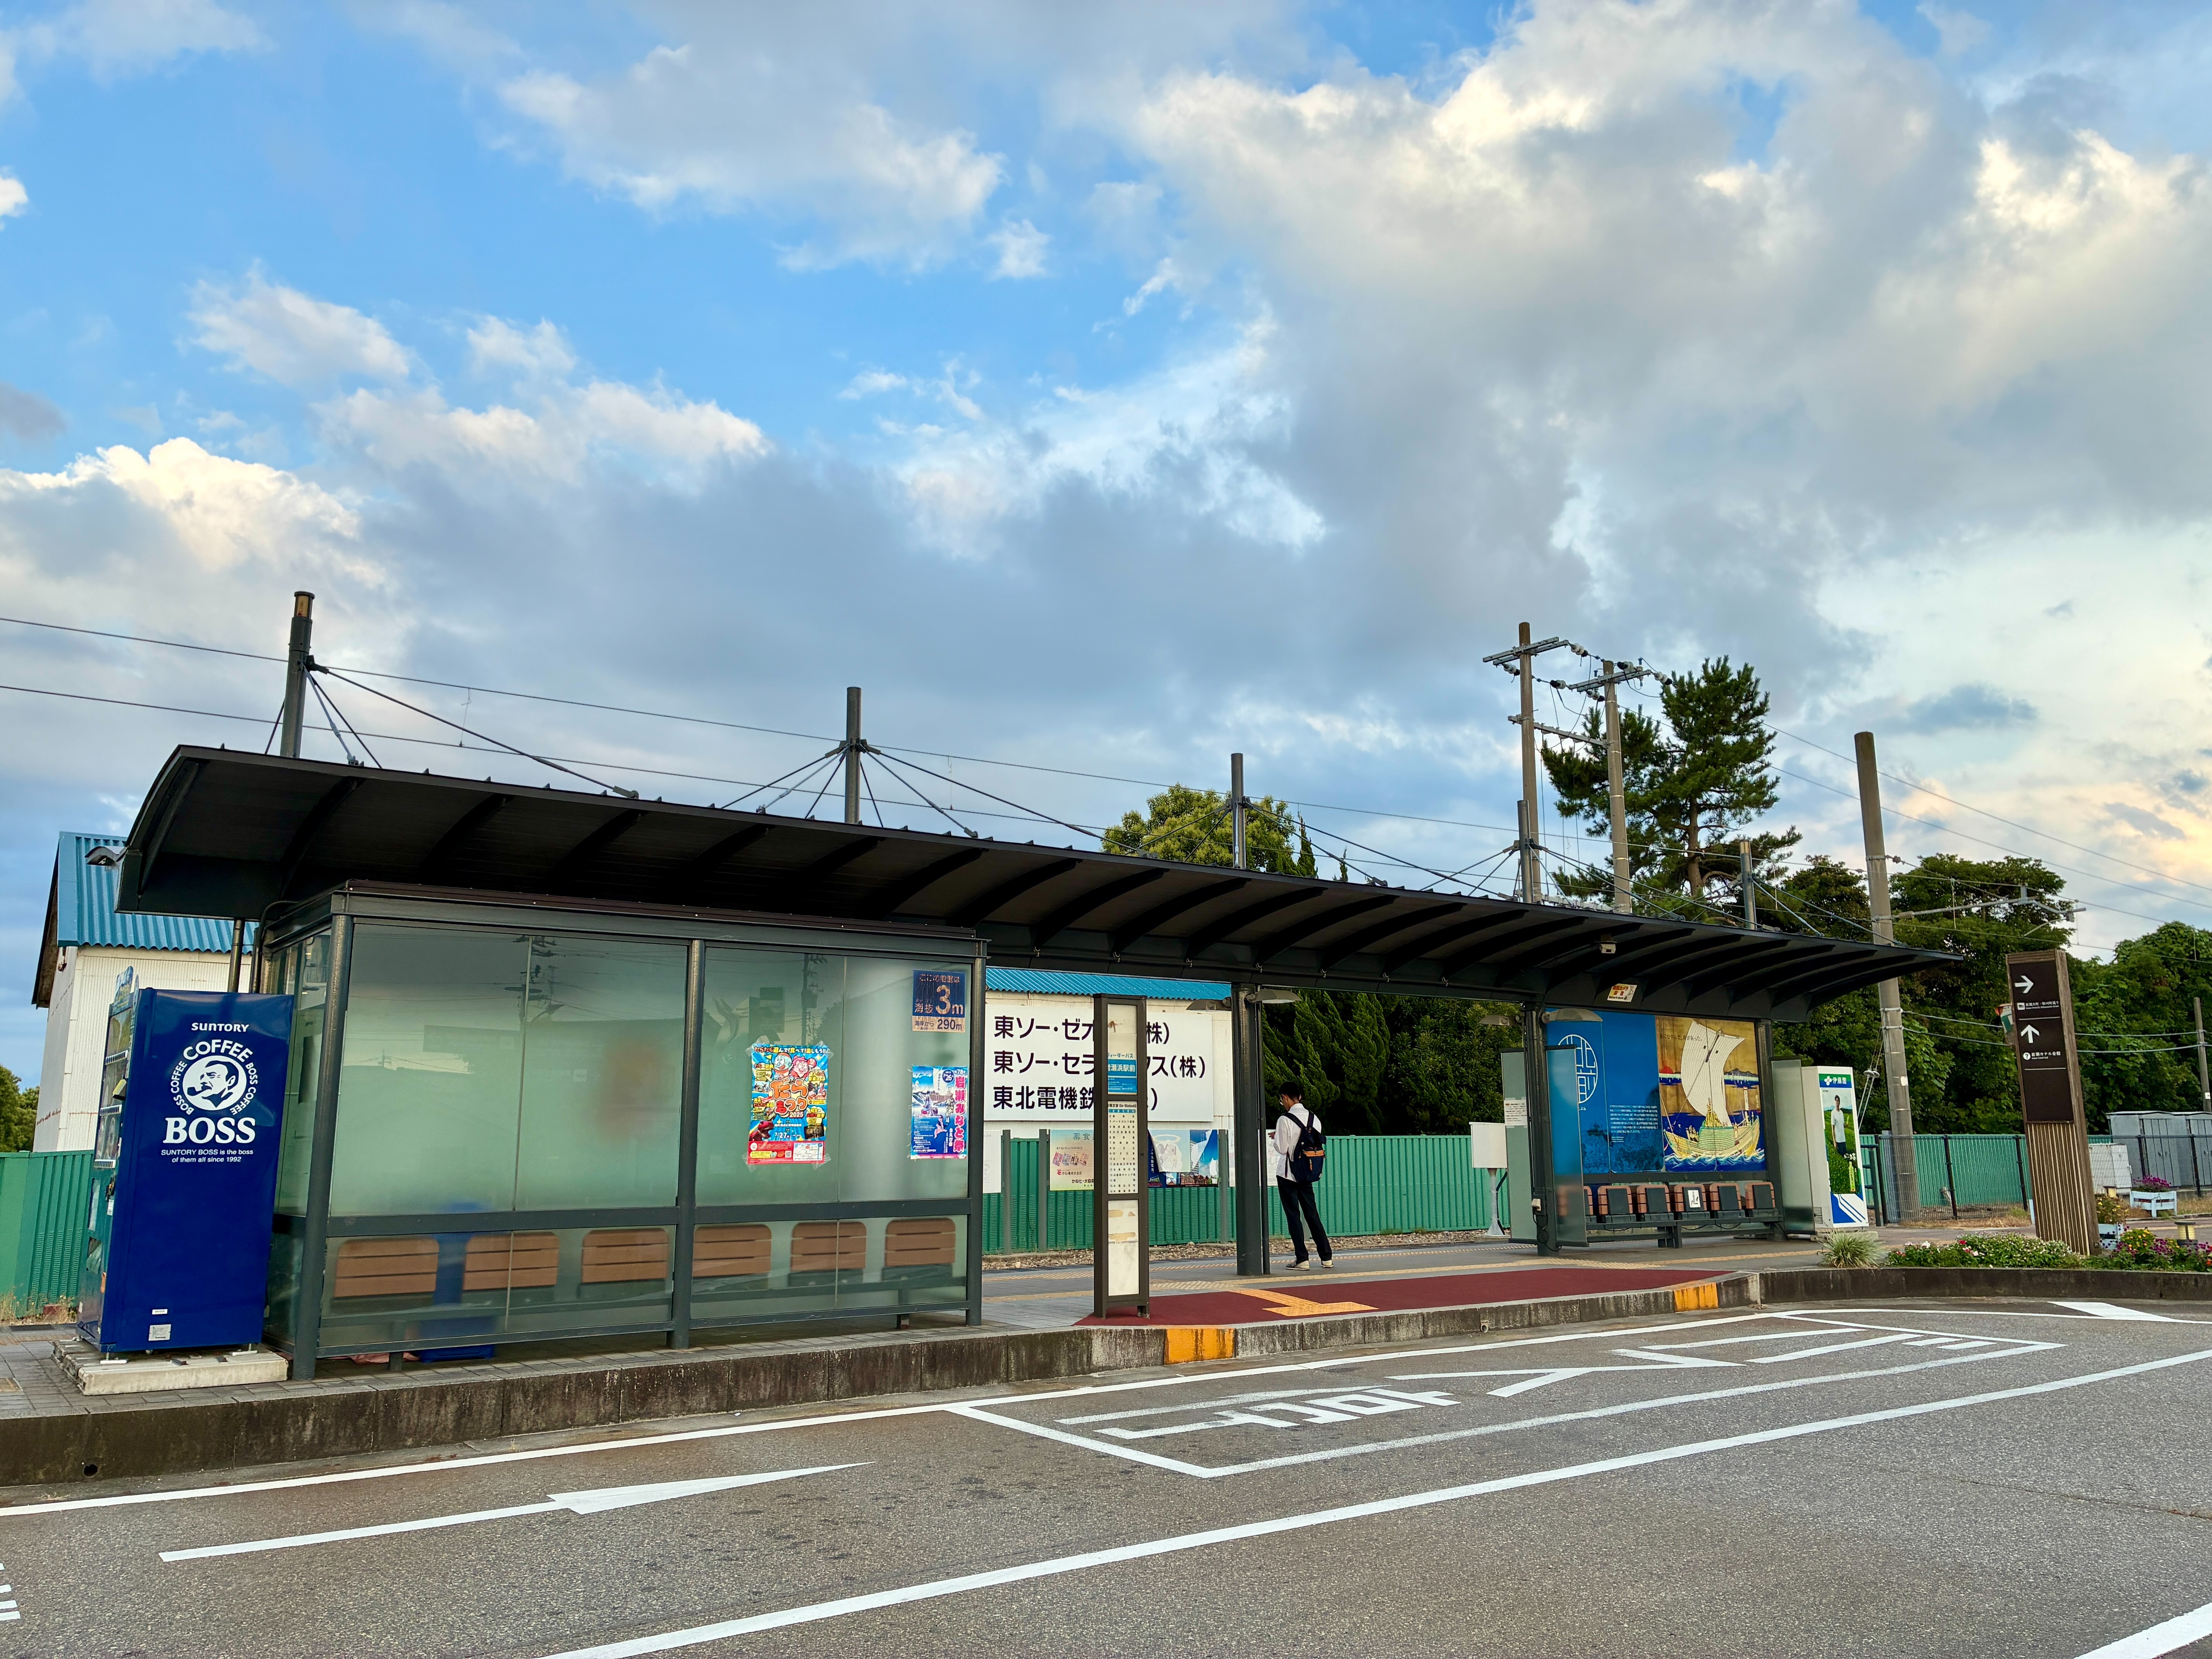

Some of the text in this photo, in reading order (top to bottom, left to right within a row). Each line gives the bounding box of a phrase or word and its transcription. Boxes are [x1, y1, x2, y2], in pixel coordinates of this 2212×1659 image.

[191, 1022, 249, 1032] SUNTORY
[937, 1019, 962, 1030] 290m
[183, 1039, 253, 1062] COFFEE
[170, 1061, 194, 1115] BOSS COFFEE
[230, 1062, 259, 1116] BOSS COFFEE
[163, 1117, 256, 1144] BOSS
